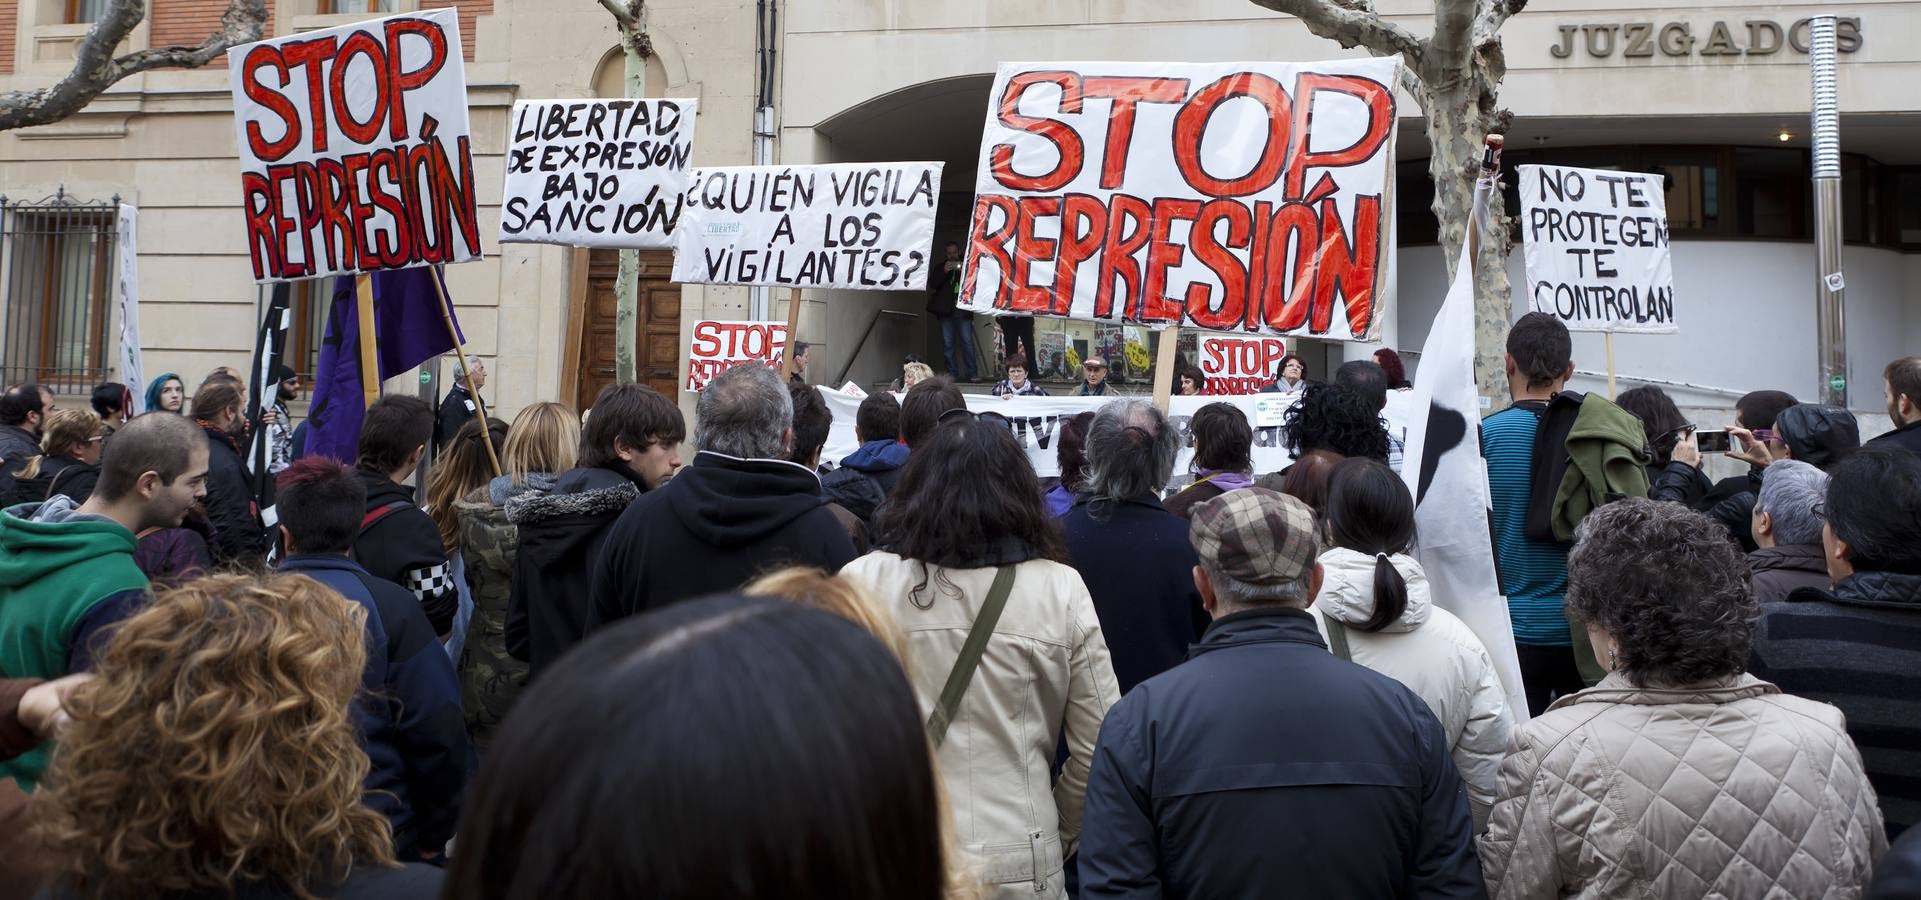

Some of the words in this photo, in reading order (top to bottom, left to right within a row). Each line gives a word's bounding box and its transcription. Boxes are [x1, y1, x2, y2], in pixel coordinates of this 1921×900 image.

[1550, 17, 1863, 59] JUZGADOS
[243, 17, 448, 162] STOP
[515, 100, 681, 143] LIBERTAD
[990, 70, 1397, 202] STOP
[508, 146, 537, 174] DE
[539, 131, 691, 172] EXPRESIÓN
[243, 112, 483, 280] REPRESIÓN
[542, 172, 620, 203] BAJO
[687, 167, 815, 213] ¿QUIÉN
[831, 168, 934, 207] VIGILA
[1539, 168, 1585, 202] NO
[1596, 176, 1650, 208] TE
[502, 184, 684, 236] SANCIÓN
[771, 214, 796, 246] A
[824, 212, 883, 248] LOS
[1530, 207, 1669, 248] PROTEGEN
[957, 171, 1382, 338] REPRESIÓN
[1566, 249, 1618, 279] TE
[1535, 280, 1673, 324] CONTROLAN
[1203, 338, 1285, 377] STOP
